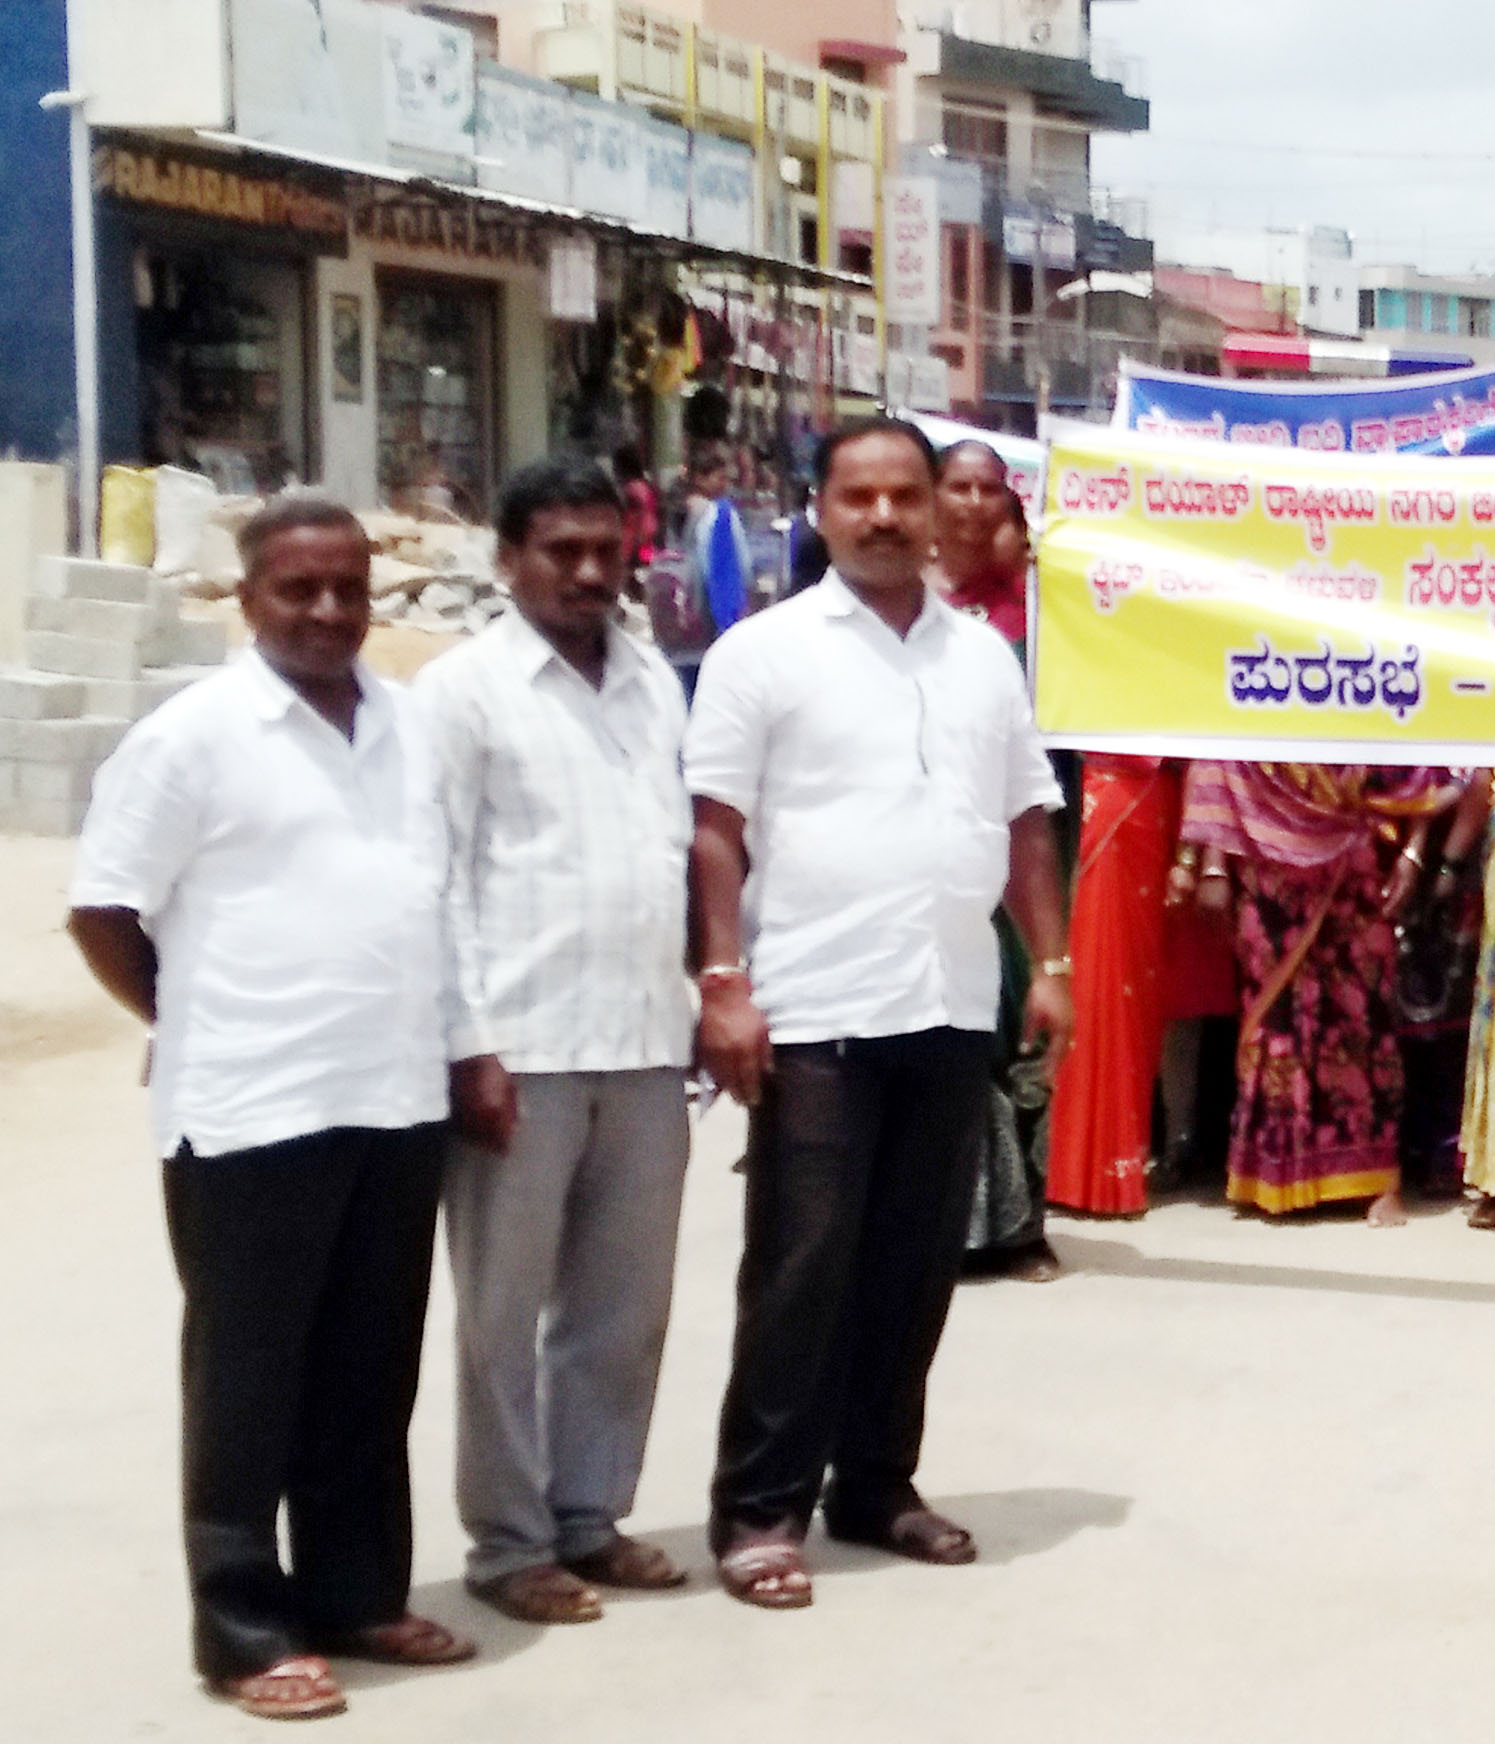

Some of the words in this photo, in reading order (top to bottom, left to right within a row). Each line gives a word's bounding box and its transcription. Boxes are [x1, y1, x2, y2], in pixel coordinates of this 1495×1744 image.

[1063, 466, 1129, 510] ದೀನ್
[1391, 486, 1457, 522] ನಗರ
[1231, 641, 1420, 718] ಪುರಸಭೆ
